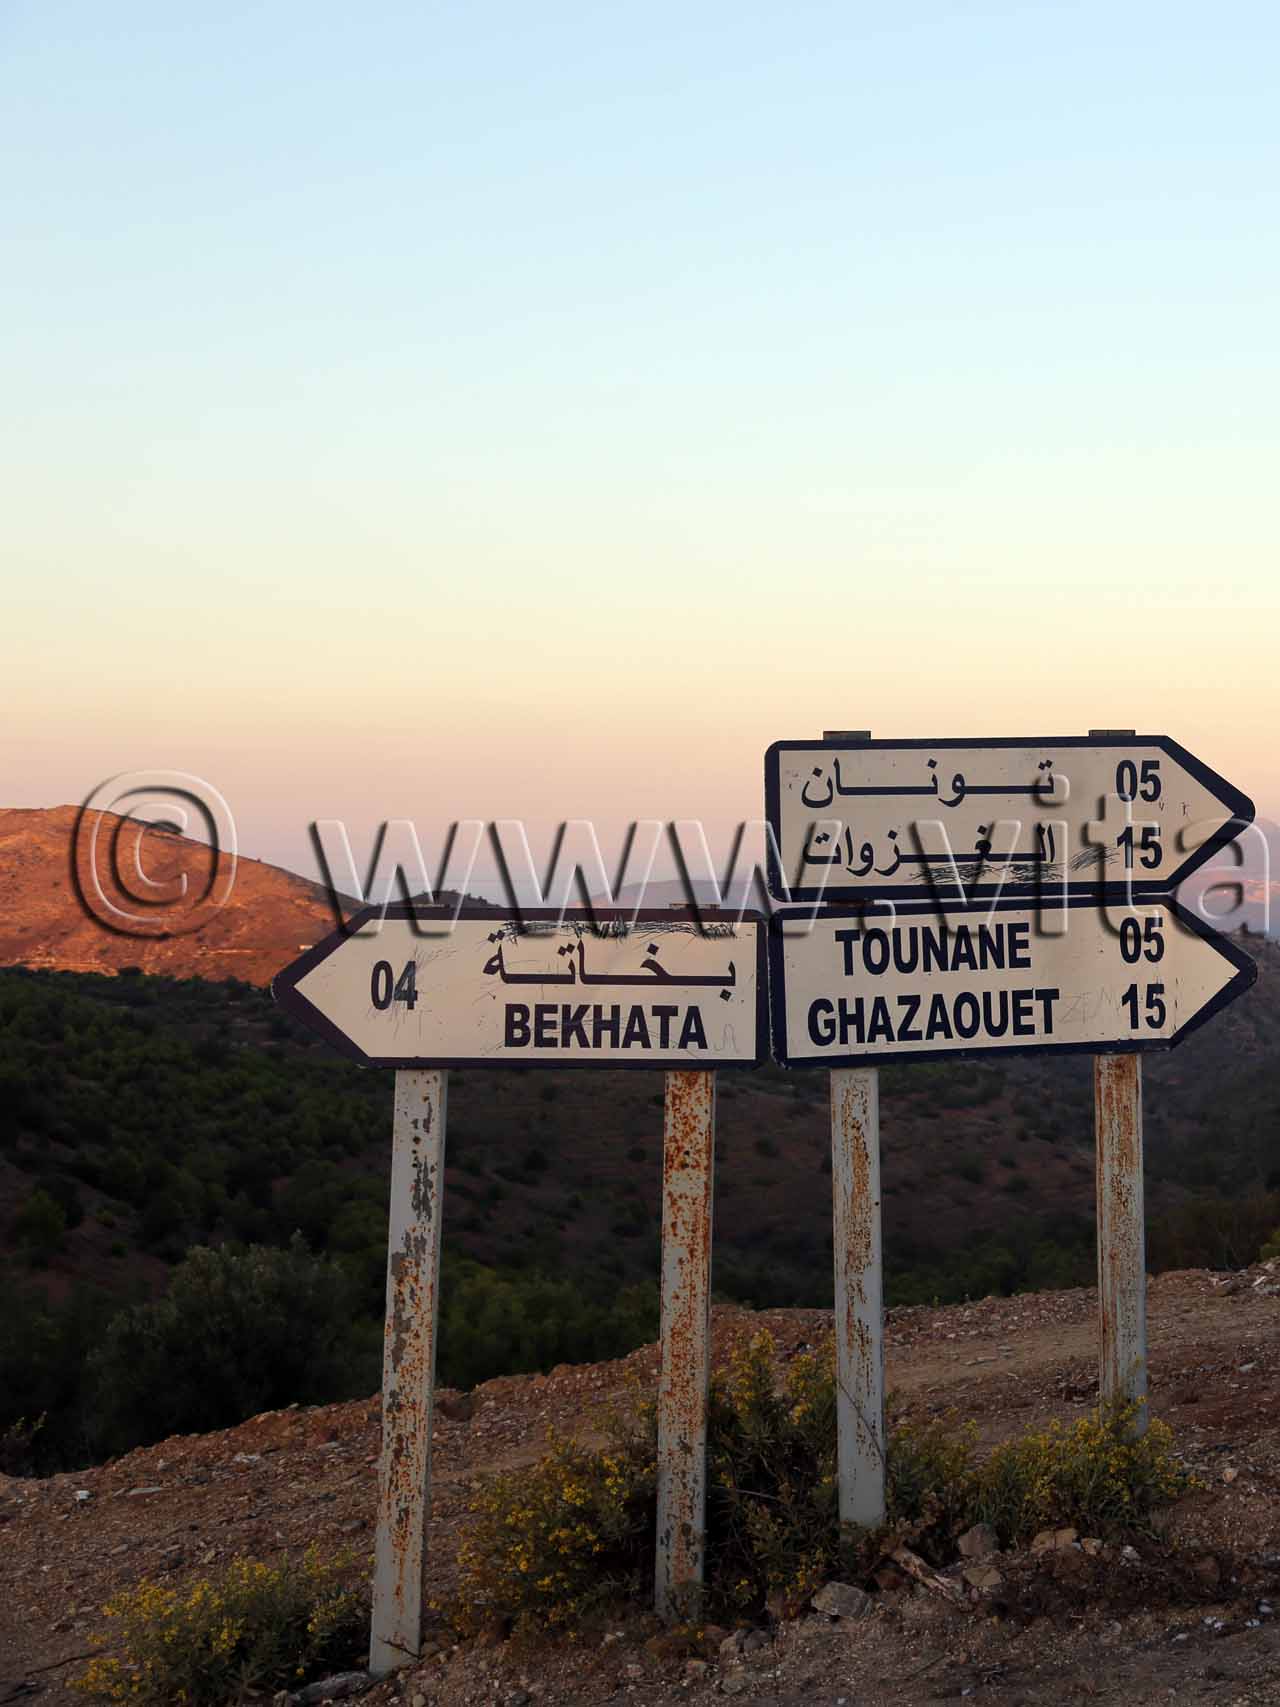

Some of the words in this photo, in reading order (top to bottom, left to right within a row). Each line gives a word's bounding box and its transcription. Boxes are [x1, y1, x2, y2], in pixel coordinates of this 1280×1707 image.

[801, 758, 1055, 808] تونان
[1115, 759, 1162, 802] 05
[803, 822, 1056, 877] الغزوات
[1117, 826, 1163, 869] 15
[482, 929, 736, 1002] بخاتة
[835, 922, 1032, 976] TOUNANE
[1119, 916, 1165, 964] 05
[371, 959, 418, 1011] 04
[503, 1003, 708, 1050] BEKHATA
[807, 987, 1060, 1046] GHAZAOUET
[1121, 984, 1167, 1030] 15
